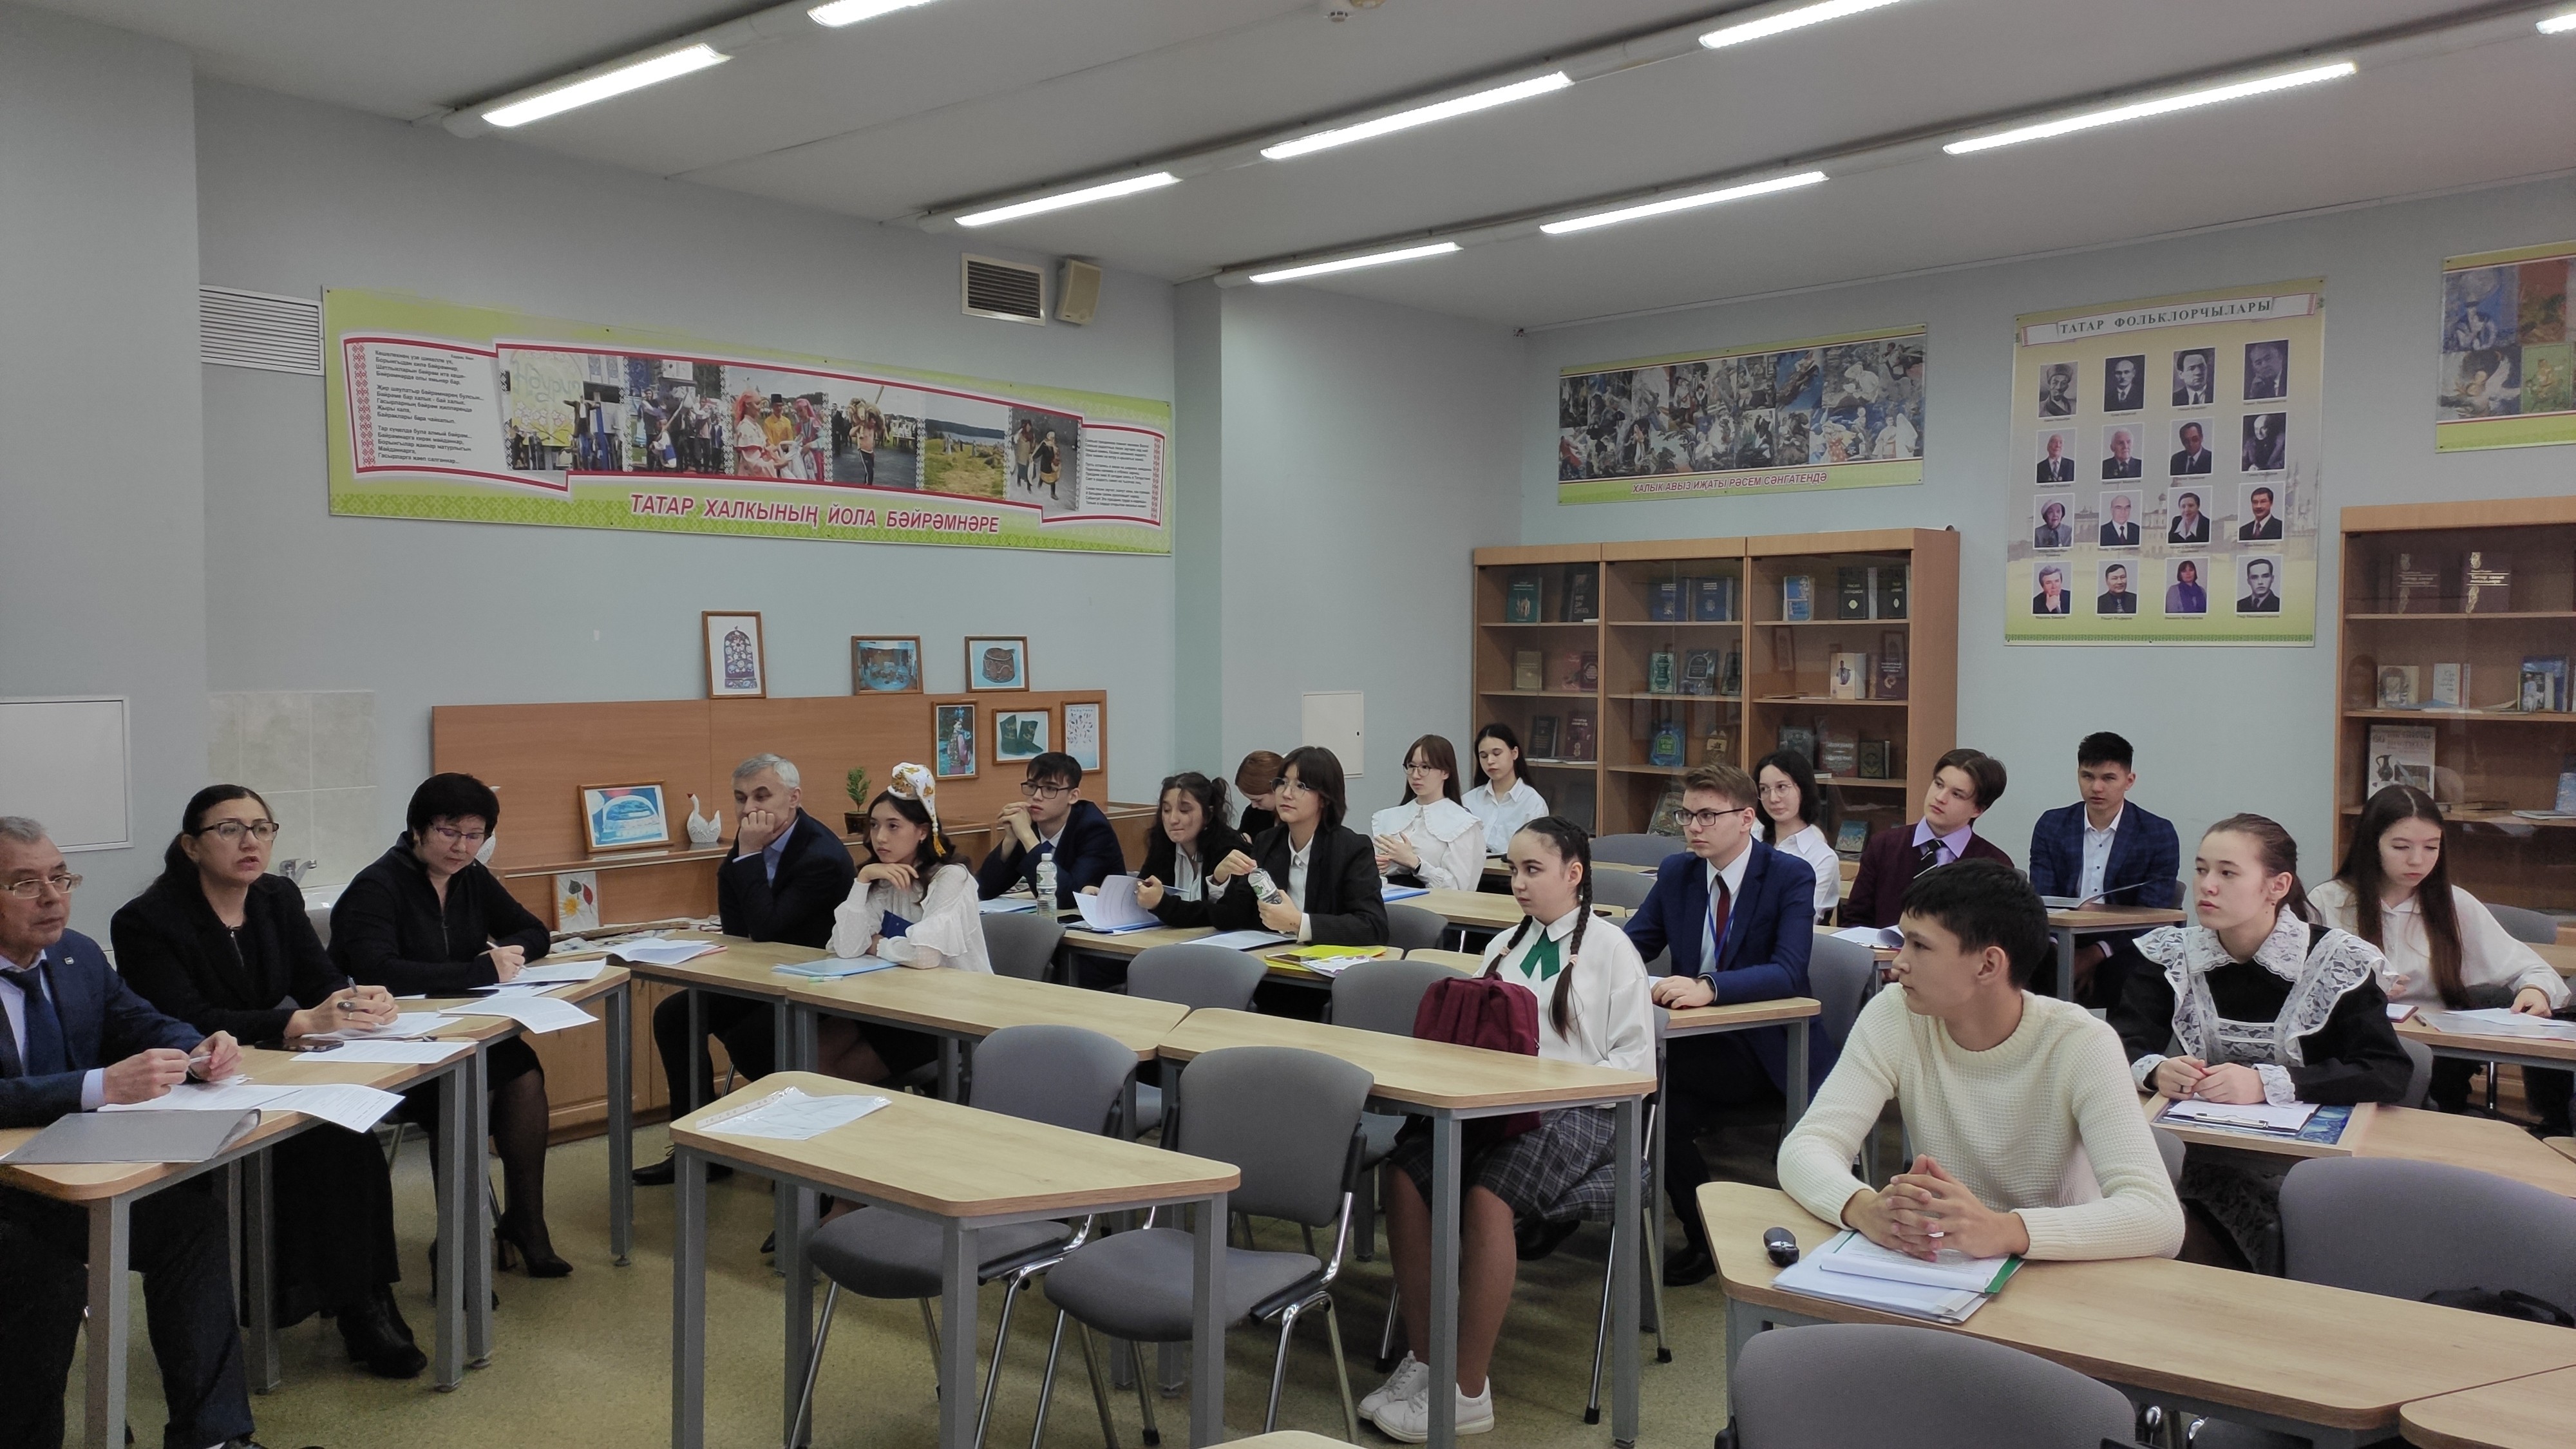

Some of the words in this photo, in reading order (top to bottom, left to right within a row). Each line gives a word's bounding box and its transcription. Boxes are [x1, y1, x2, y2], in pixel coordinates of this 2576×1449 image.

[2060, 319, 2104, 334] ТАТАР
[2114, 300, 2271, 328] ФОЛЬКЛОРЧЫЛАРЫ
[1633, 483, 1663, 493] ХАЛЫК
[1665, 481, 1692, 491] АВЫЗ
[1693, 478, 1727, 491] ИҖАТЫ
[1728, 477, 1762, 488] РӘСЕМ
[1764, 472, 1827, 486] СӘНГАТЕНДӘ
[631, 494, 694, 515] ТАТАР
[704, 499, 819, 527] ХАЛКЫНЫҢ
[828, 503, 876, 526] ЙОЛА
[886, 509, 999, 533] БӘЙРӘМНӘРЕ
